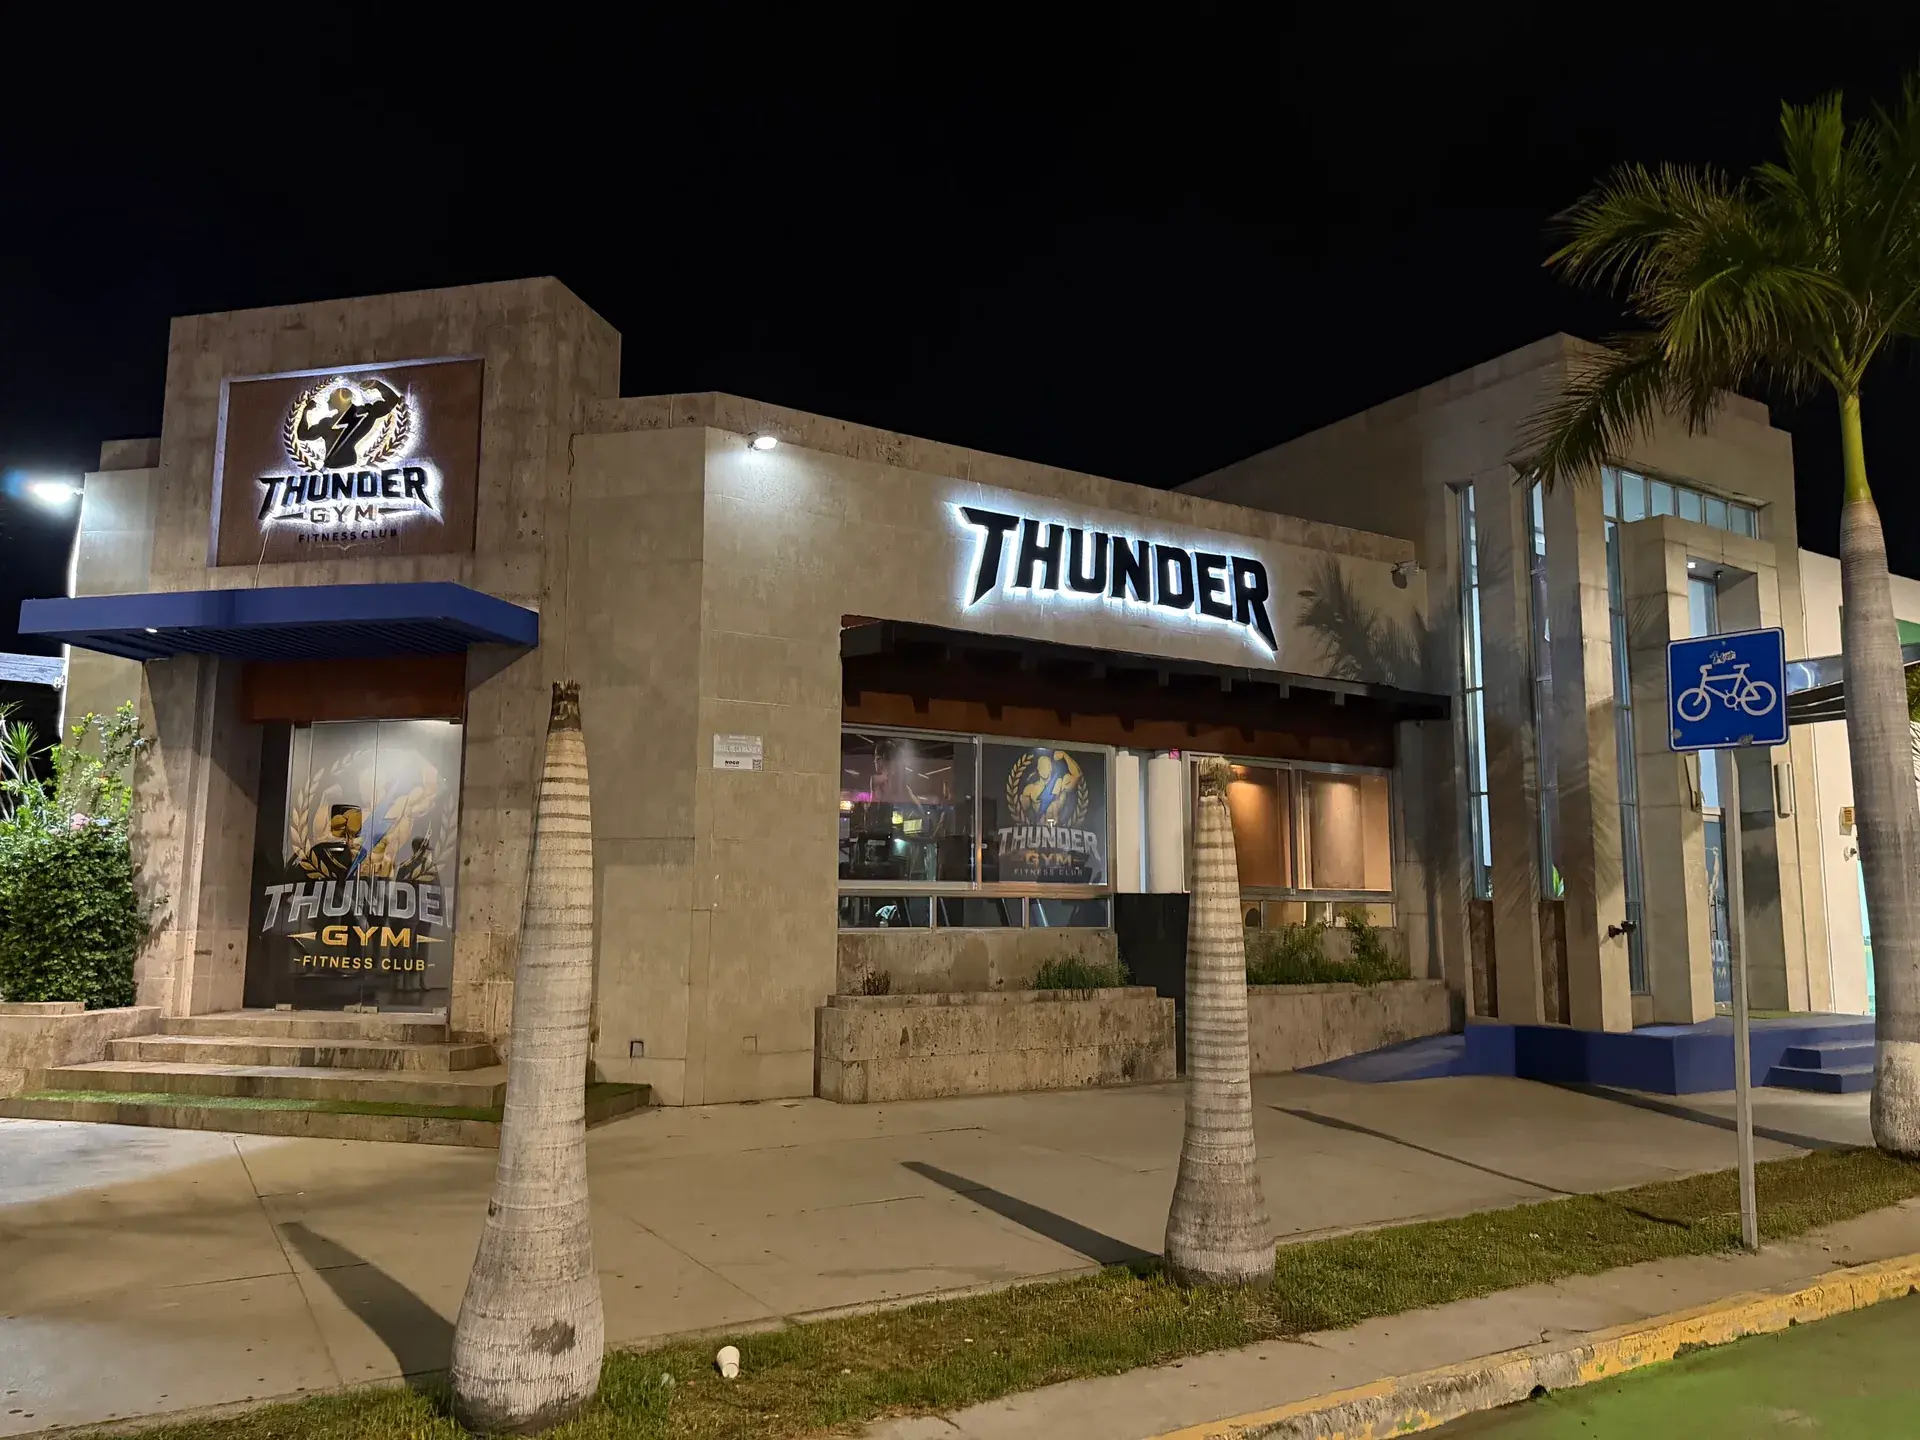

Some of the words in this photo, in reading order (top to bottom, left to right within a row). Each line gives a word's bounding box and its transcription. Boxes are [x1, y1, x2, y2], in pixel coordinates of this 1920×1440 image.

[257, 466, 435, 520] THUNDER
[310, 504, 375, 523] GYM
[299, 531, 357, 543] FITNESS
[361, 529, 398, 539] CLUB
[959, 506, 1278, 651] THUNDER
[998, 826, 1102, 861] THUNDER
[1025, 851, 1072, 867] GYM
[321, 925, 412, 947] GYM
[302, 955, 373, 970] FITNESS
[381, 958, 426, 971] CLUB
